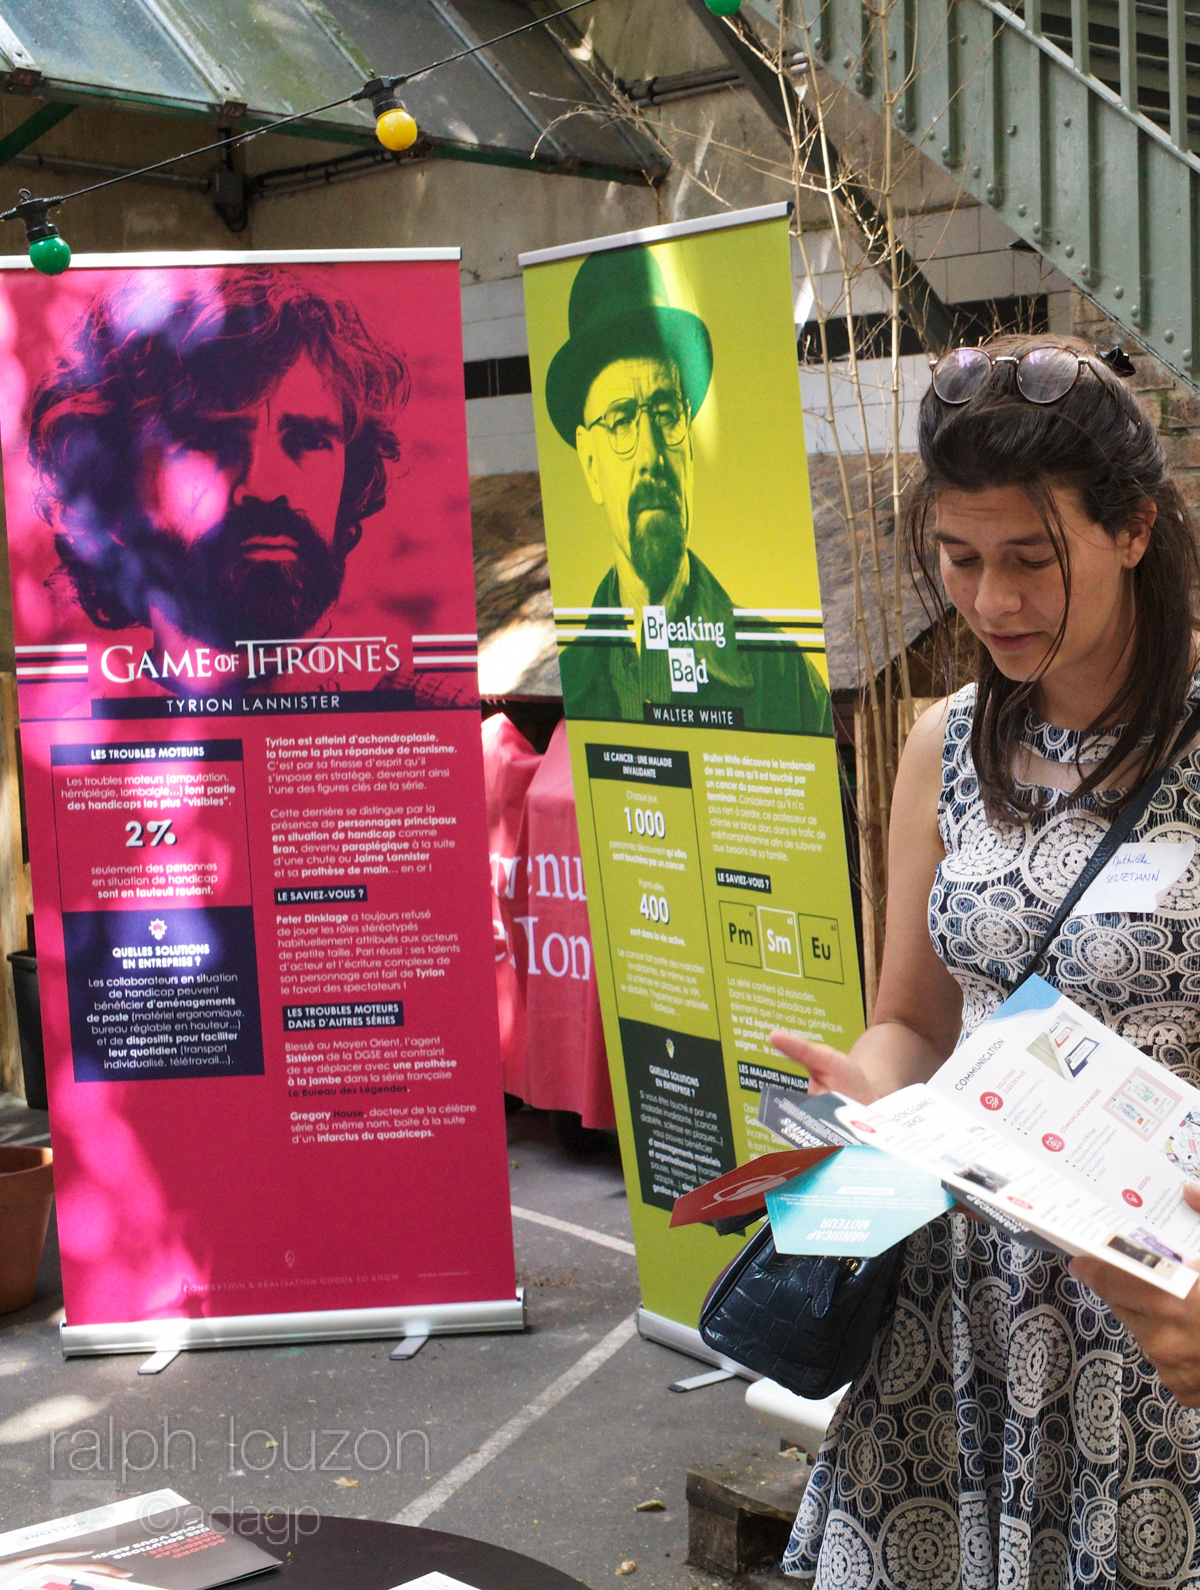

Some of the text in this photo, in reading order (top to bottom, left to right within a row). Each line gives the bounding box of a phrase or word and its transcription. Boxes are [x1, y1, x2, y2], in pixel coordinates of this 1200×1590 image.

[647, 616, 726, 648] Breaking
[671, 658, 709, 684] Bad
[167, 696, 340, 713] TYRION LANNISTER
[653, 707, 733, 725] WALTER WHITE
[265, 737, 295, 747] Tyrion
[298, 736, 312, 745] est
[315, 735, 346, 745] atteint
[91, 747, 204, 759] LES TROUBLES MOTEURS
[267, 750, 276, 758] la
[279, 748, 308, 758] forme
[310, 749, 320, 757] la
[323, 748, 343, 759] plus
[345, 745, 394, 757] répandue
[397, 745, 410, 754] de
[297, 762, 313, 771] par
[316, 761, 327, 769] sa
[330, 759, 362, 768] finesse
[603, 752, 610, 761] LE
[611, 752, 634, 763] CANCER
[637, 755, 647, 765] UNE
[648, 756, 672, 767] MALADIE
[703, 753, 815, 771] Walter White découvre le lendemain
[623, 766, 656, 778] INVALIDANTE
[705, 766, 713, 775] de
[715, 768, 725, 776] ses
[735, 770, 745, 778] ans
[760, 772, 768, 780] est
[770, 772, 793, 783] touché
[795, 776, 805, 785] par
[67, 777, 82, 786] Les
[84, 776, 122, 785] troubles
[125, 775, 163, 784] moteurs
[185, 785, 204, 794] font
[207, 785, 236, 795] partie
[297, 784, 314, 793] des
[317, 782, 349, 794] figures
[351, 782, 371, 792] clés
[373, 782, 387, 791] de
[390, 782, 399, 790] la
[68, 801, 85, 810] des
[88, 800, 141, 811] handicaps
[144, 799, 158, 808] les
[160, 799, 181, 810] plus
[91, 863, 217, 875] seulement des personnes
[92, 874, 218, 887] en situation de handicap
[718, 873, 725, 882] LE
[726, 874, 764, 888] SAVIEZ-VOUS
[98, 886, 213, 899] sont en fauteuil roulant.
[277, 889, 364, 901] LE SAVIEZ-VOUS ?
[640, 893, 669, 924] 400
[277, 916, 301, 924] Peter
[304, 914, 348, 923] Dinklage
[361, 911, 399, 921] toujours
[401, 910, 431, 919] refusé
[729, 922, 831, 960] Pm Sm Eu
[112, 944, 210, 958] QUELLES SOLUTIONS
[123, 957, 201, 969] EN ENTREPRISE ?
[287, 1004, 399, 1017] LES TROUBLES MOTEURS
[288, 1015, 395, 1028] DANS D'AUTRES SÉRIES
[955, 1038, 1005, 1091] COMMUNICATION
[649, 1064, 699, 1087] QUELLES SOLUTIONS
[739, 1064, 748, 1074] LES
[750, 1066, 779, 1082] MALADIES
[996, 1068, 1017, 1090] SOLUTIONS
[655, 1077, 662, 1088] EN
[663, 1080, 691, 1097] ENTREPRISE
[966, 1194, 1021, 1233] HANDICAP
[820, 1218, 871, 1229] MOTEUR
[806, 1230, 870, 1242] HANDICAP
[91, 1523, 205, 1560] POUR VOUS AIDER
[112, 1527, 210, 1560] DES SOLUTIONS
[172, 1537, 226, 1559] ACCORD
